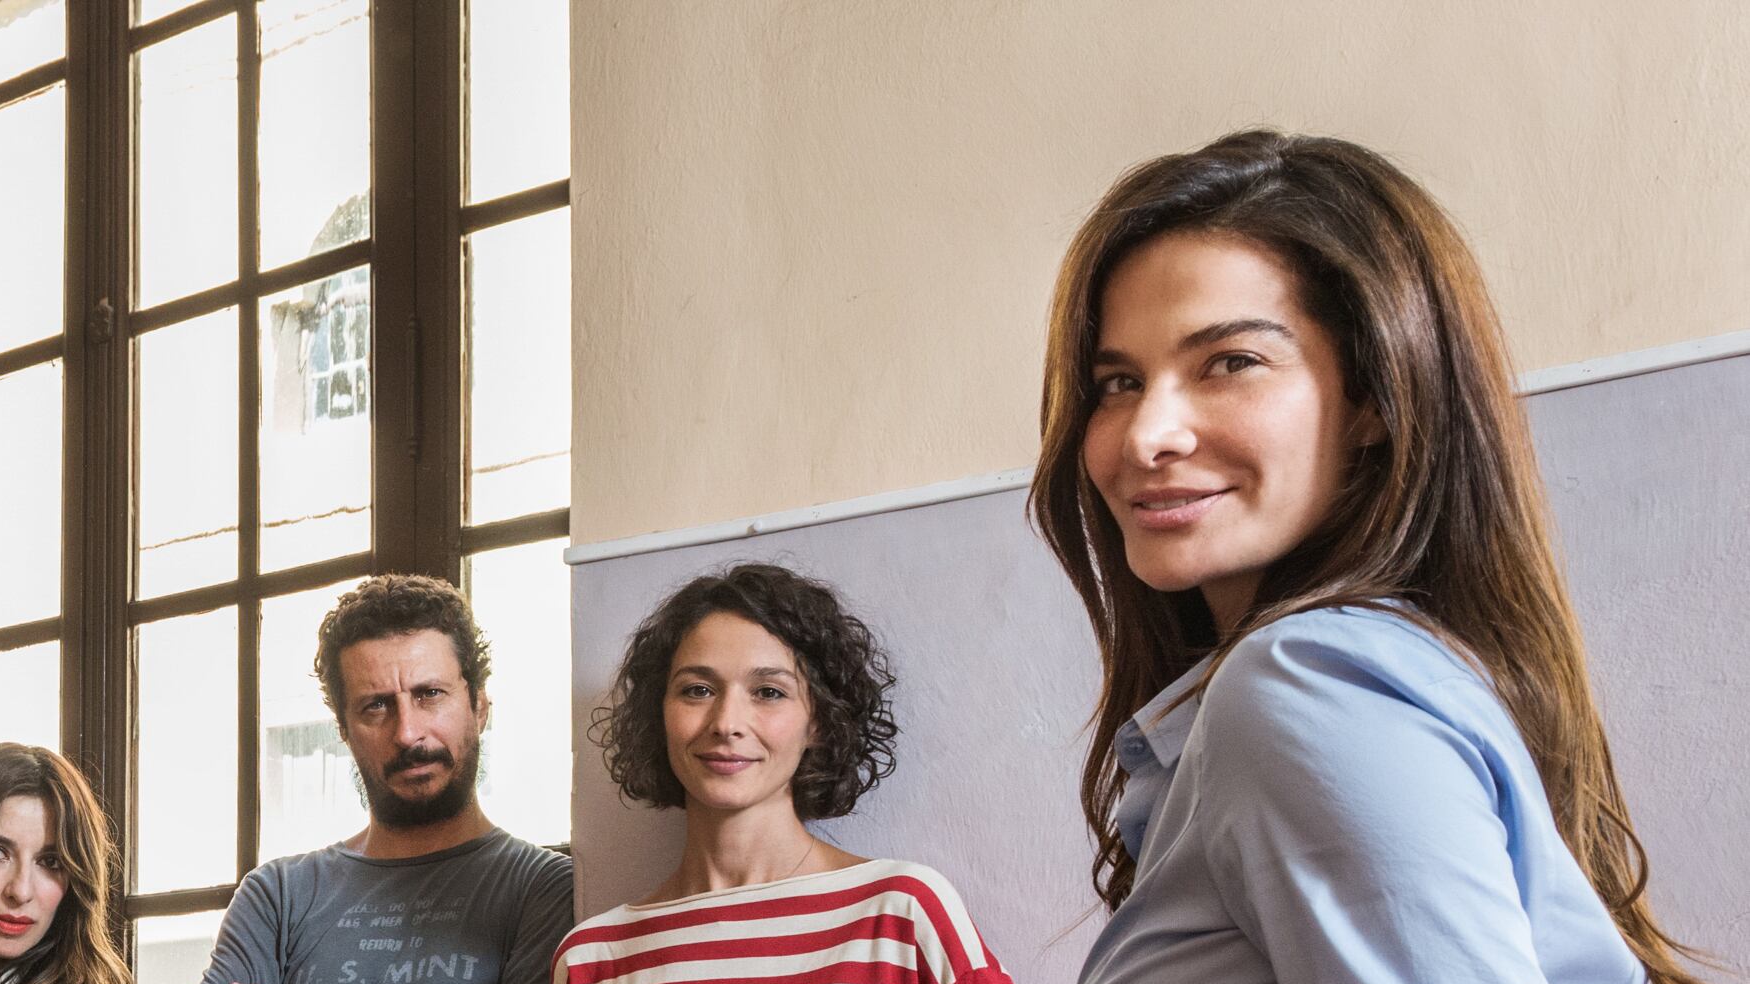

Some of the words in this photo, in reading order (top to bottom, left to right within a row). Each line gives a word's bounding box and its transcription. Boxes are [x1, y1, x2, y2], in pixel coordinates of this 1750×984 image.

[359, 938, 404, 951] RETURN
[410, 936, 424, 948] TO
[337, 960, 366, 984] S.
[383, 953, 479, 984] MINT
